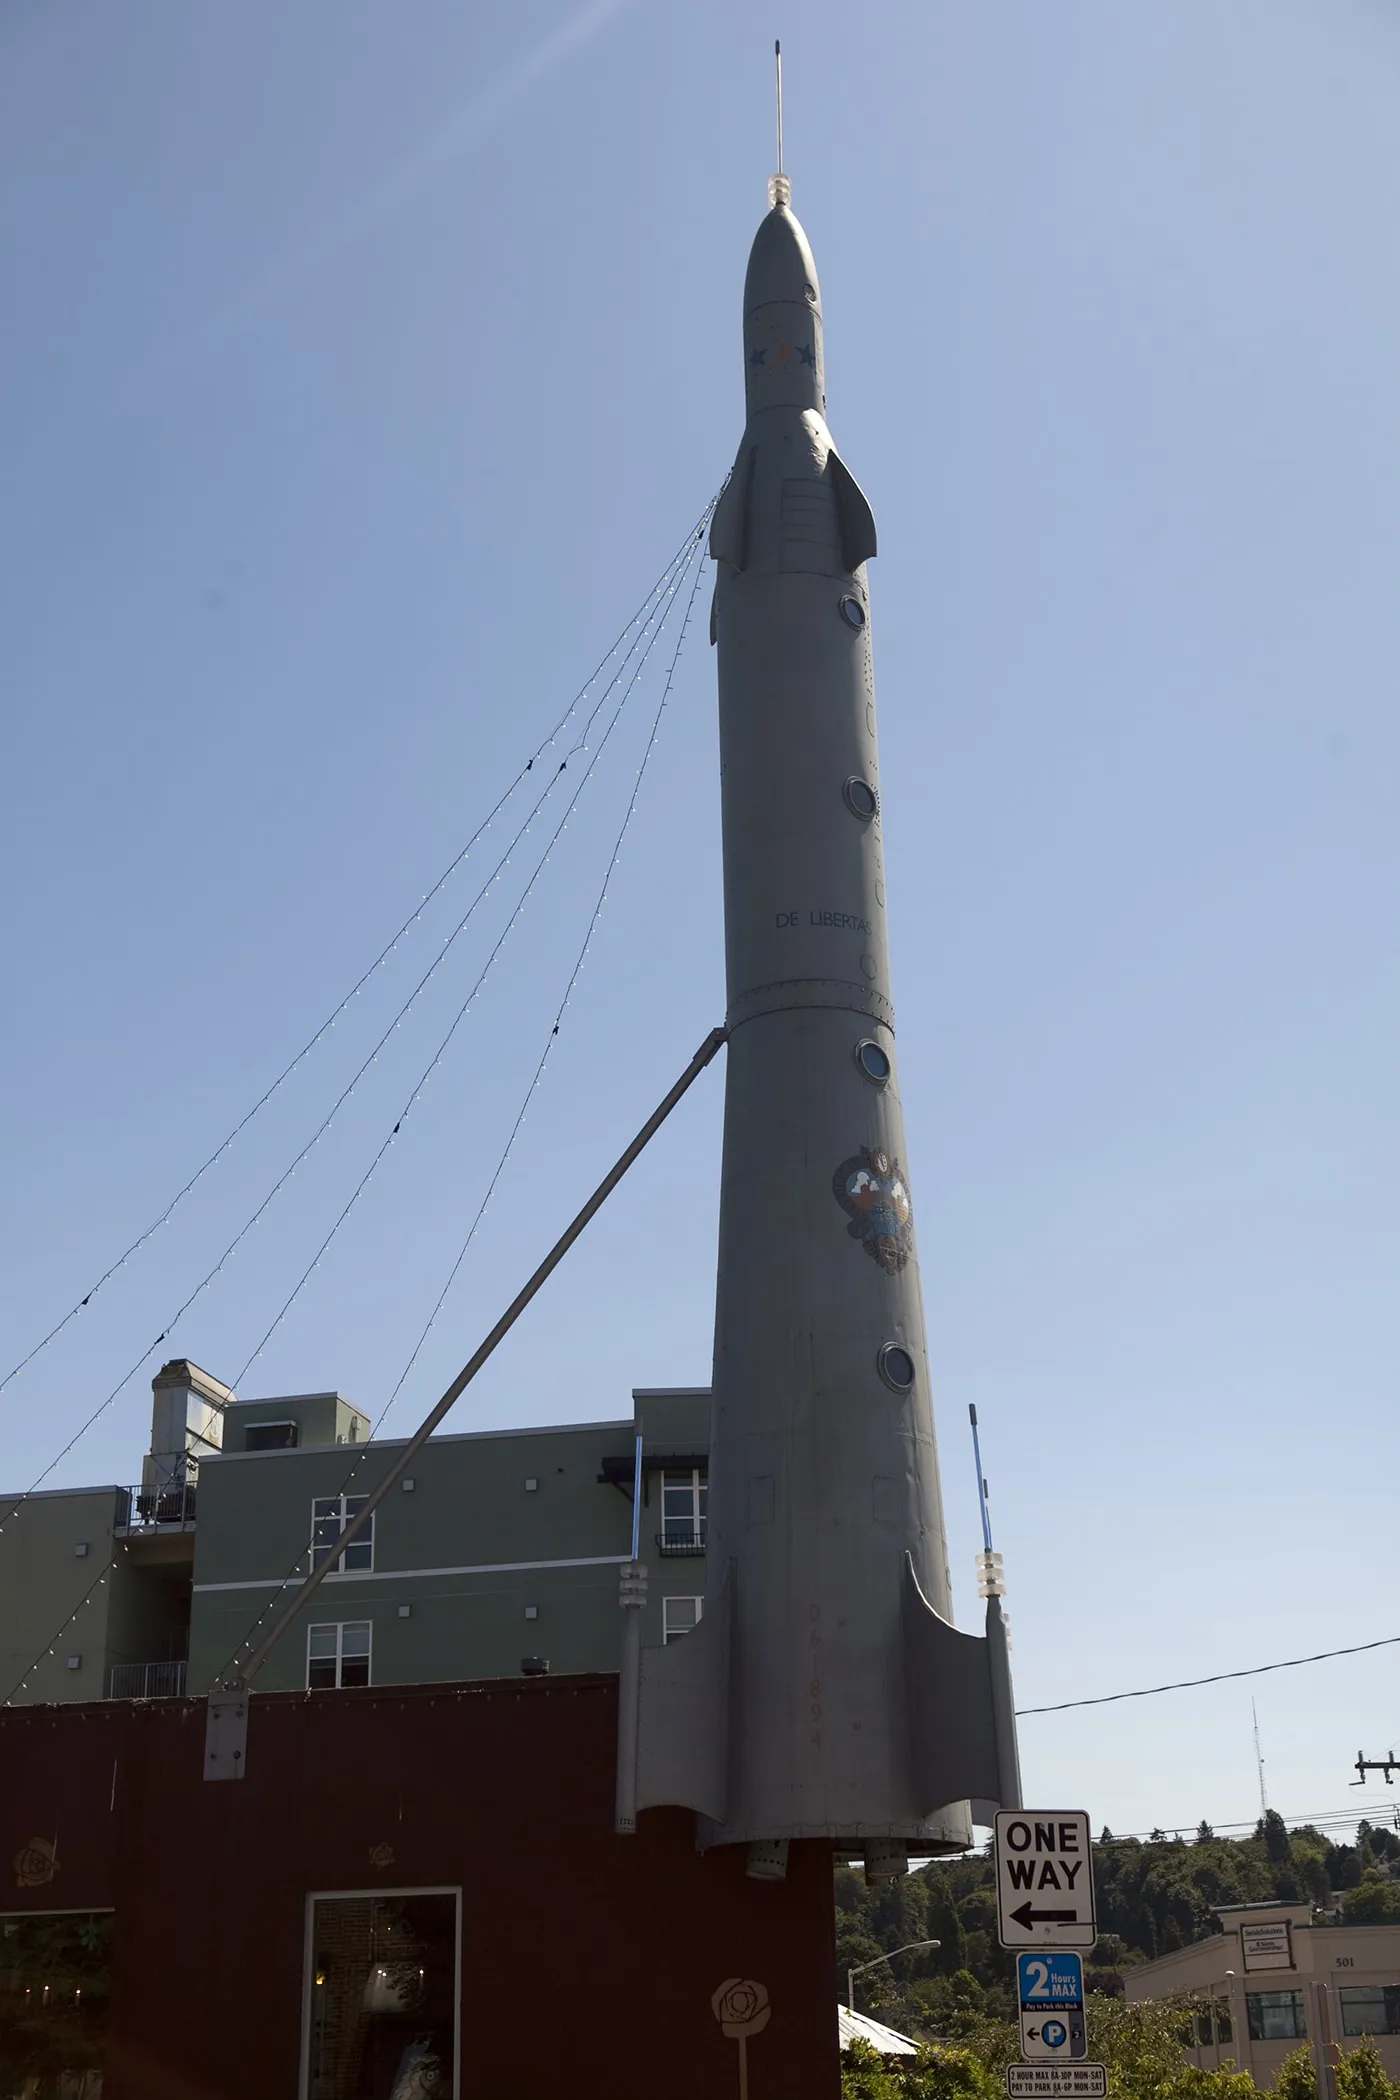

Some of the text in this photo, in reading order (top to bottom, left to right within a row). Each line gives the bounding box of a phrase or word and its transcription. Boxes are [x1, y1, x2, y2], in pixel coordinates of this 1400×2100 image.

[776, 910, 872, 936] DE LIBERTAS
[1006, 1821, 1079, 1853] ONE
[1006, 1859, 1083, 1890] WAY
[1336, 1957, 1355, 1967] 501
[1026, 1961, 1076, 1997] 2 Hours
[1052, 1984, 1077, 1997] MAX
[1026, 2003, 1036, 2011] Pay
[1048, 2025, 1061, 2043] P
[1011, 2071, 1102, 2080] 2 HOUR MAX 8A-10P MON-SAT
[1011, 2083, 1023, 2091] PAY
[1025, 2083, 1033, 2091] TO
[1035, 2083, 1051, 2091] PARK
[1074, 2083, 1102, 2091] MON-SAT
